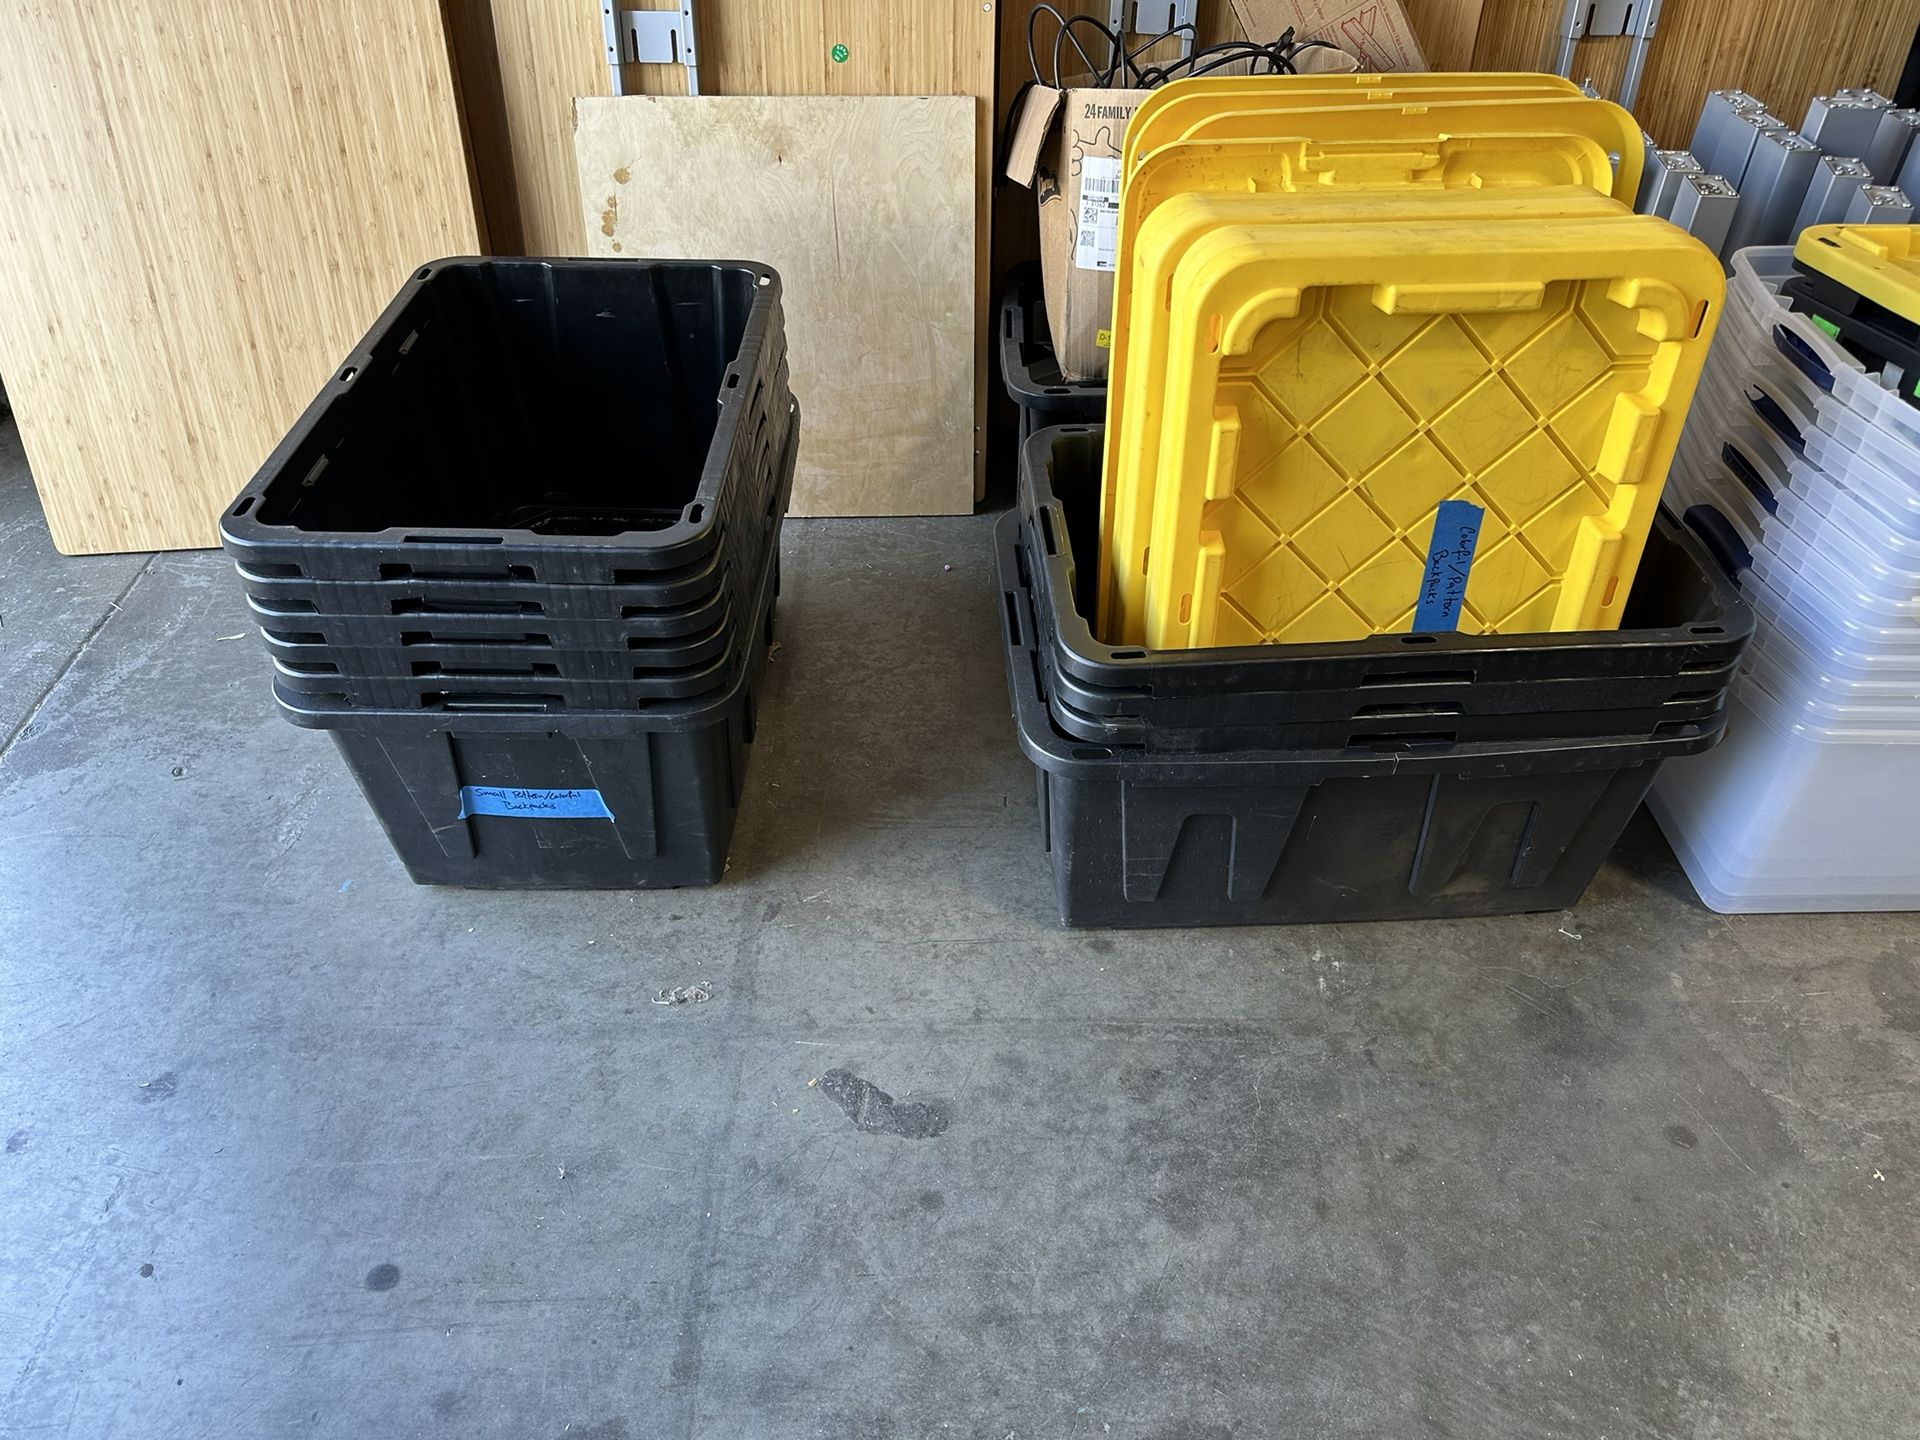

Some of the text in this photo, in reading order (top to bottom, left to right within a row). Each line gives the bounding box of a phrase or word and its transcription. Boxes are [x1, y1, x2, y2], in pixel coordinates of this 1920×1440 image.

[1084, 103, 1131, 120] 24 FAMILY
[475, 788, 507, 799] Small
